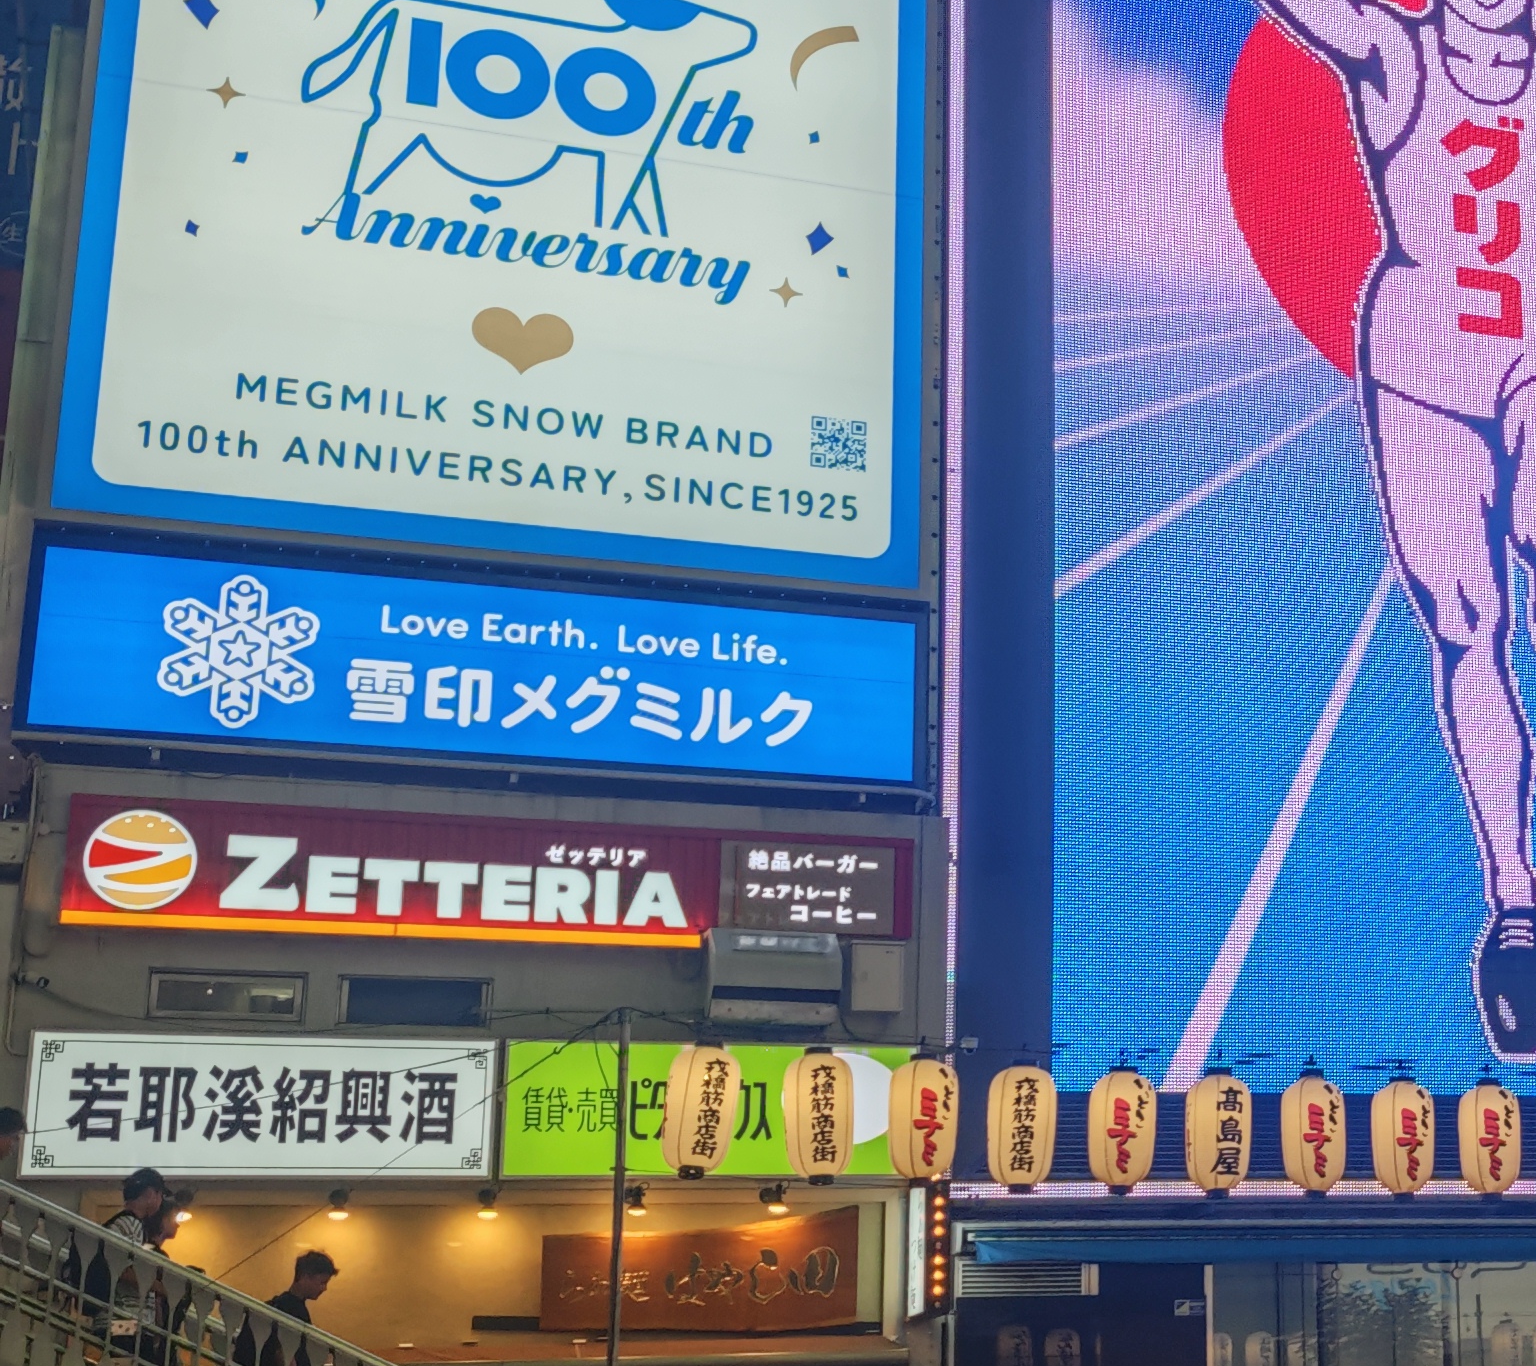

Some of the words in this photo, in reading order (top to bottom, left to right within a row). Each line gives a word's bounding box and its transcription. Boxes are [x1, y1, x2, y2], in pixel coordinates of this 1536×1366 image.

[300, 190, 753, 306] Anniversary
[1439, 116, 1527, 340] グリコ
[136, 419, 260, 462] 100th
[235, 370, 448, 425] MEGMILK
[472, 398, 605, 441] SNOW
[625, 415, 775, 460] BRAND
[380, 603, 470, 641] Love
[481, 612, 599, 652] Earth.
[617, 622, 702, 661] Love
[710, 629, 789, 669] Life.
[345, 657, 815, 749] 雪印メグミルク
[218, 833, 690, 929] ZETTERIA
[544, 842, 648, 870] ゼッテリア
[746, 848, 881, 874] 絶品バーガー
[744, 881, 853, 903] フェアトレード
[789, 903, 879, 926] コーヒー
[521, 1086, 619, 1134] 賃貸・売買
